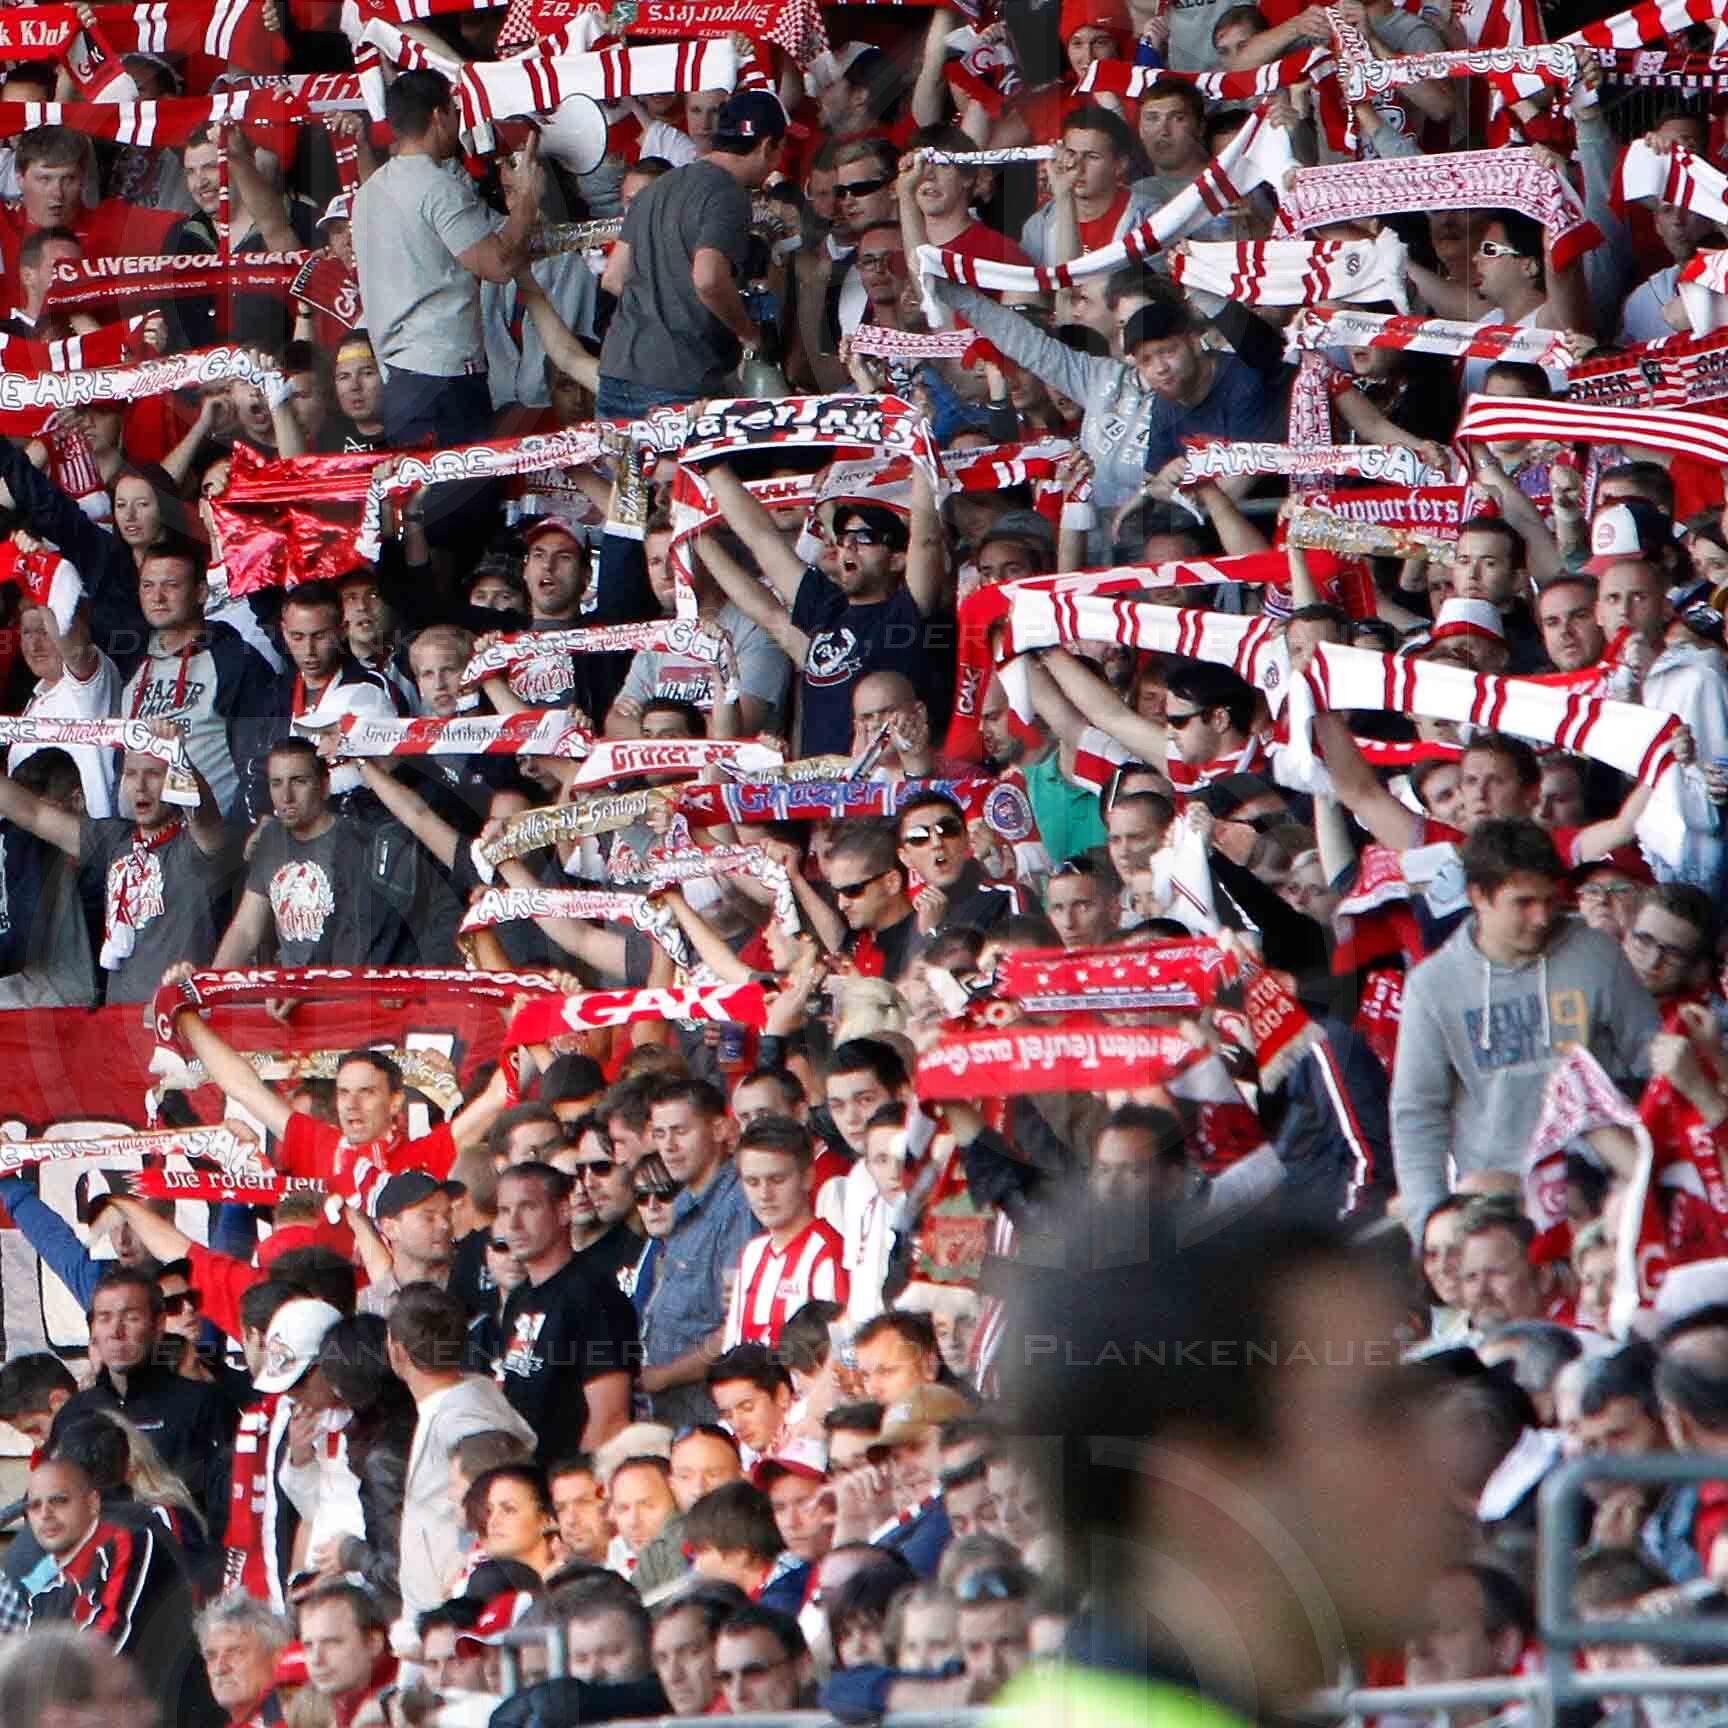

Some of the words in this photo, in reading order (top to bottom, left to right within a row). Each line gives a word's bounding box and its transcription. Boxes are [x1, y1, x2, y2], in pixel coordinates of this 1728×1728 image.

[84, 252, 225, 280] LIVERPOOL
[563, 985, 739, 1032] GAK
[163, 1169, 201, 1190] Die
[208, 1171, 274, 1191] roten
